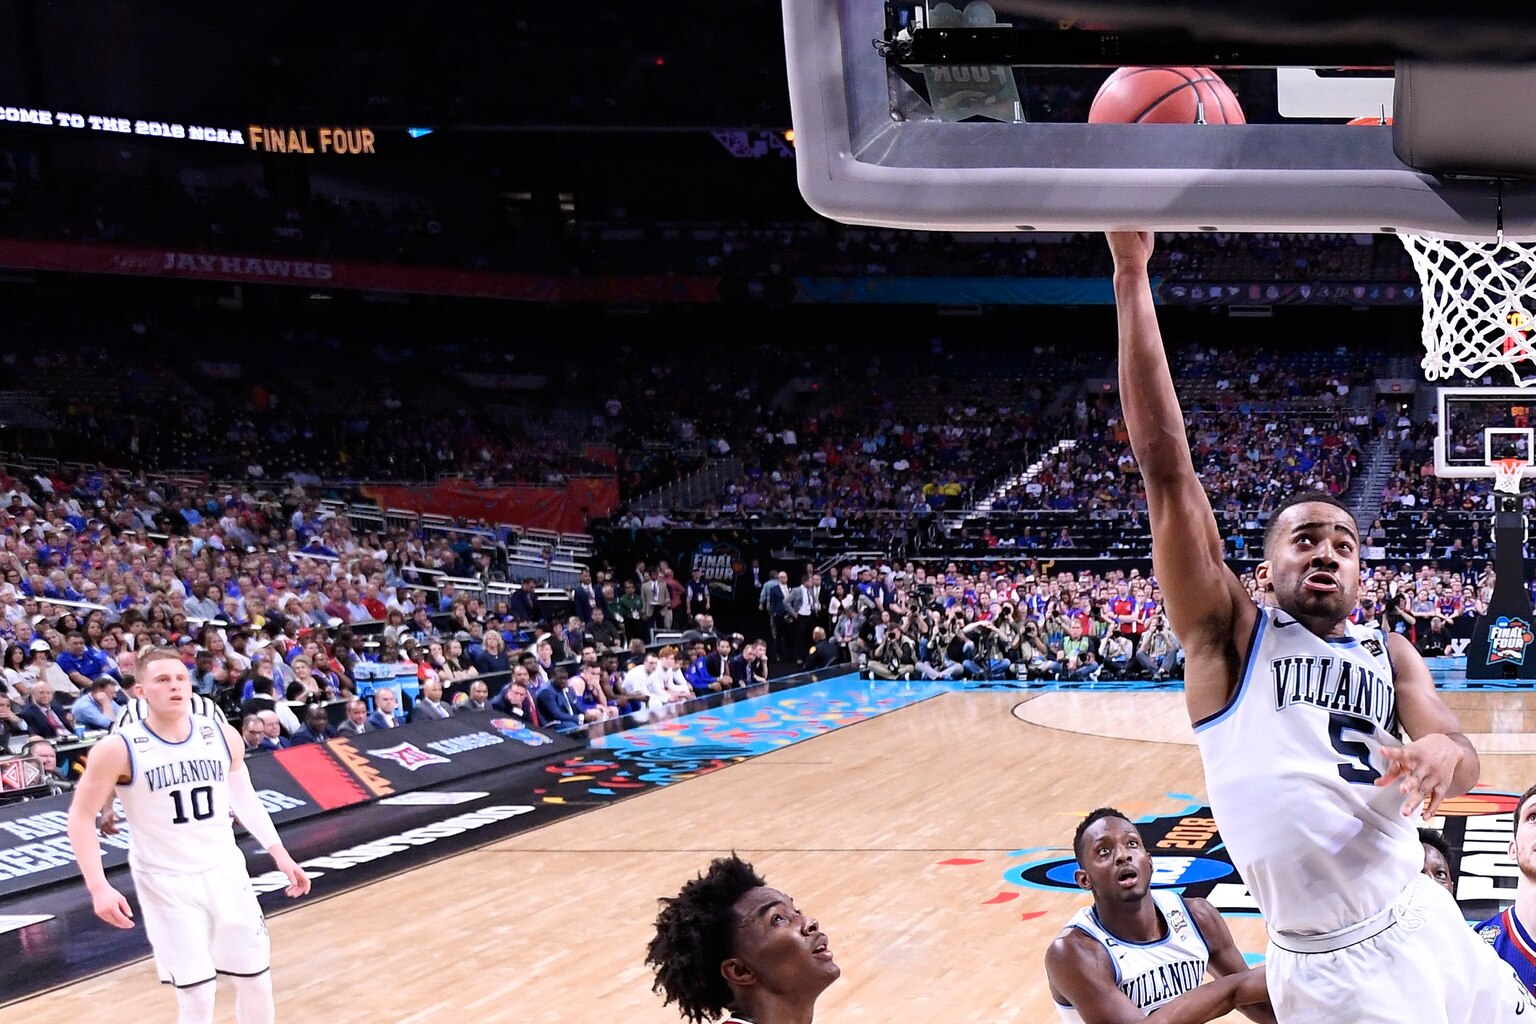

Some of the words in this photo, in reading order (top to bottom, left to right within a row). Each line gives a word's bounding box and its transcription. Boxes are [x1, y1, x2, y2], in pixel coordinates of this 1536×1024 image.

[55, 111, 85, 128] TO
[88, 114, 132, 133] THE
[134, 119, 185, 139] 2018
[188, 125, 245, 144] NCAA
[249, 124, 315, 154] FINAL
[319, 127, 376, 155] FOUR
[163, 252, 333, 279] JAYHAWKS
[692, 553, 733, 570] FINAL
[1490, 626, 1523, 640] FINAL
[1493, 638, 1524, 649] FOUR
[1327, 711, 1386, 786] 5
[144, 759, 225, 793] VILLANOVA
[169, 785, 215, 825] 10
